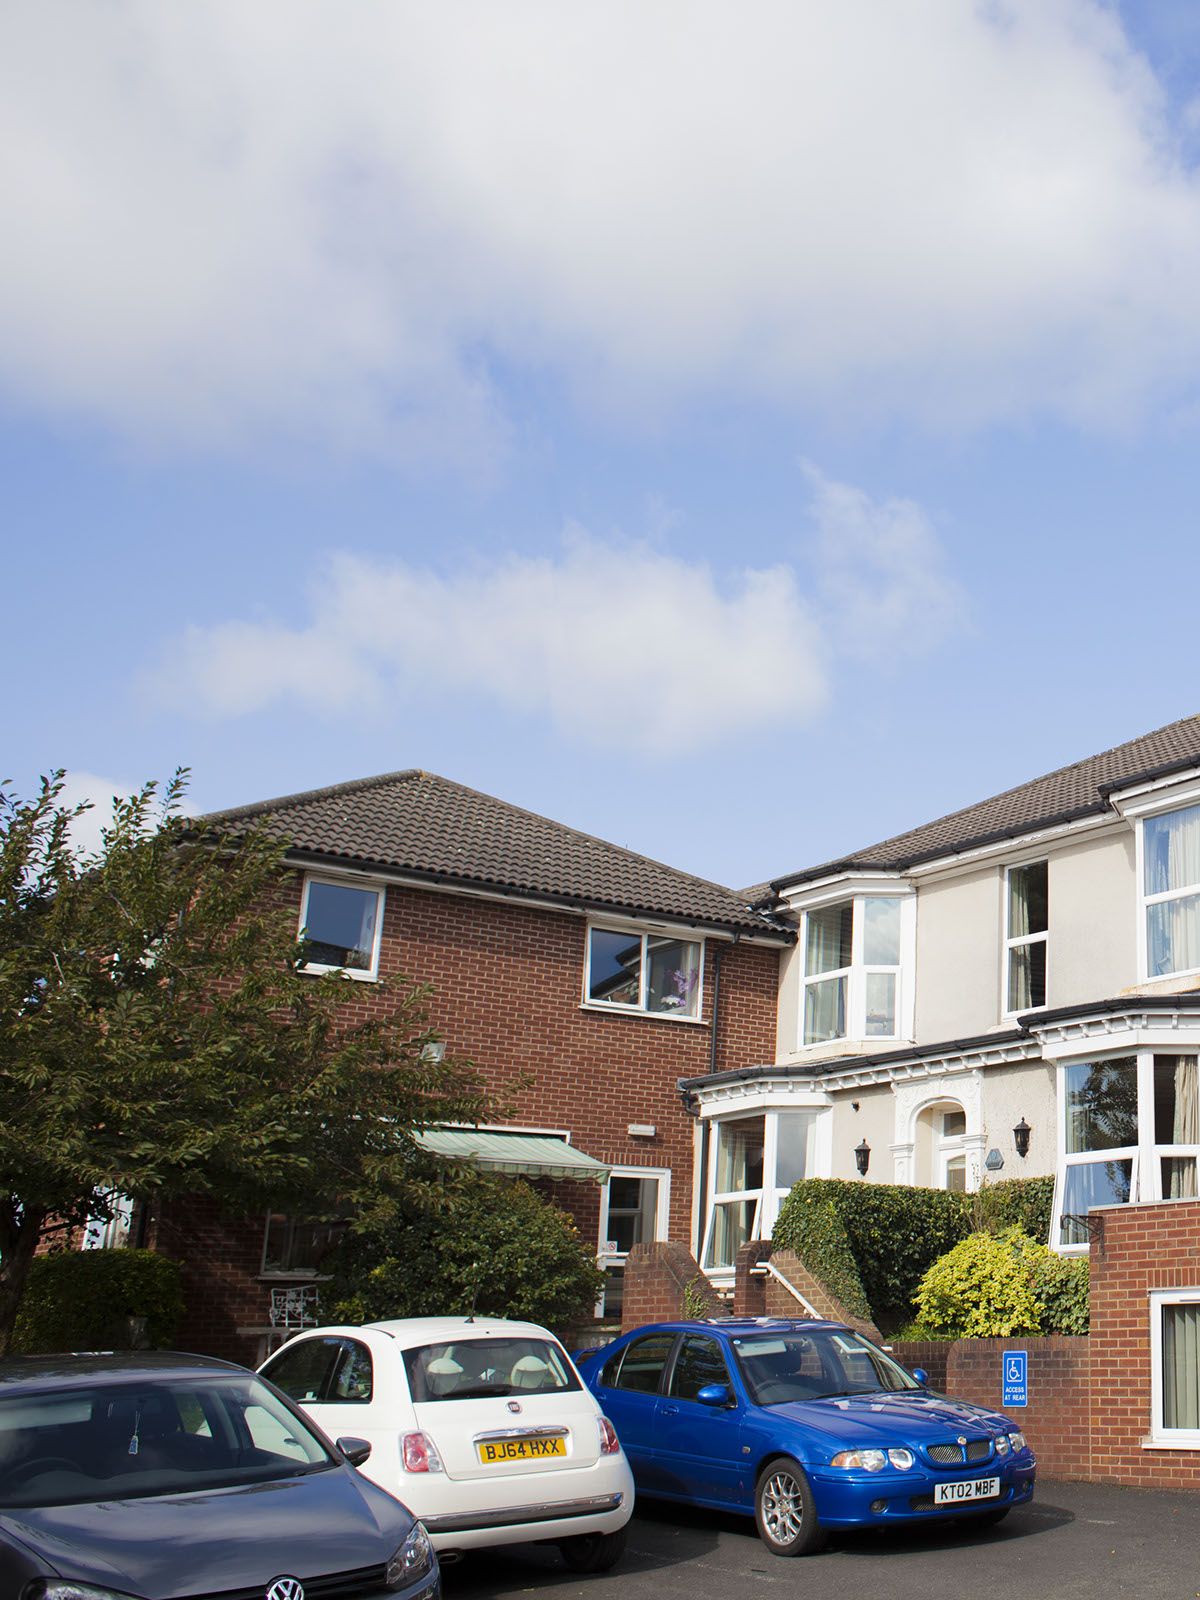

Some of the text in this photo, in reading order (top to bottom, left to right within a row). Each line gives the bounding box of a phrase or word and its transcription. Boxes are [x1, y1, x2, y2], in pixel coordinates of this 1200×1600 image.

[485, 1439, 560, 1460] BJ64 HXX
[940, 1479, 996, 1500] KT02 MBF
